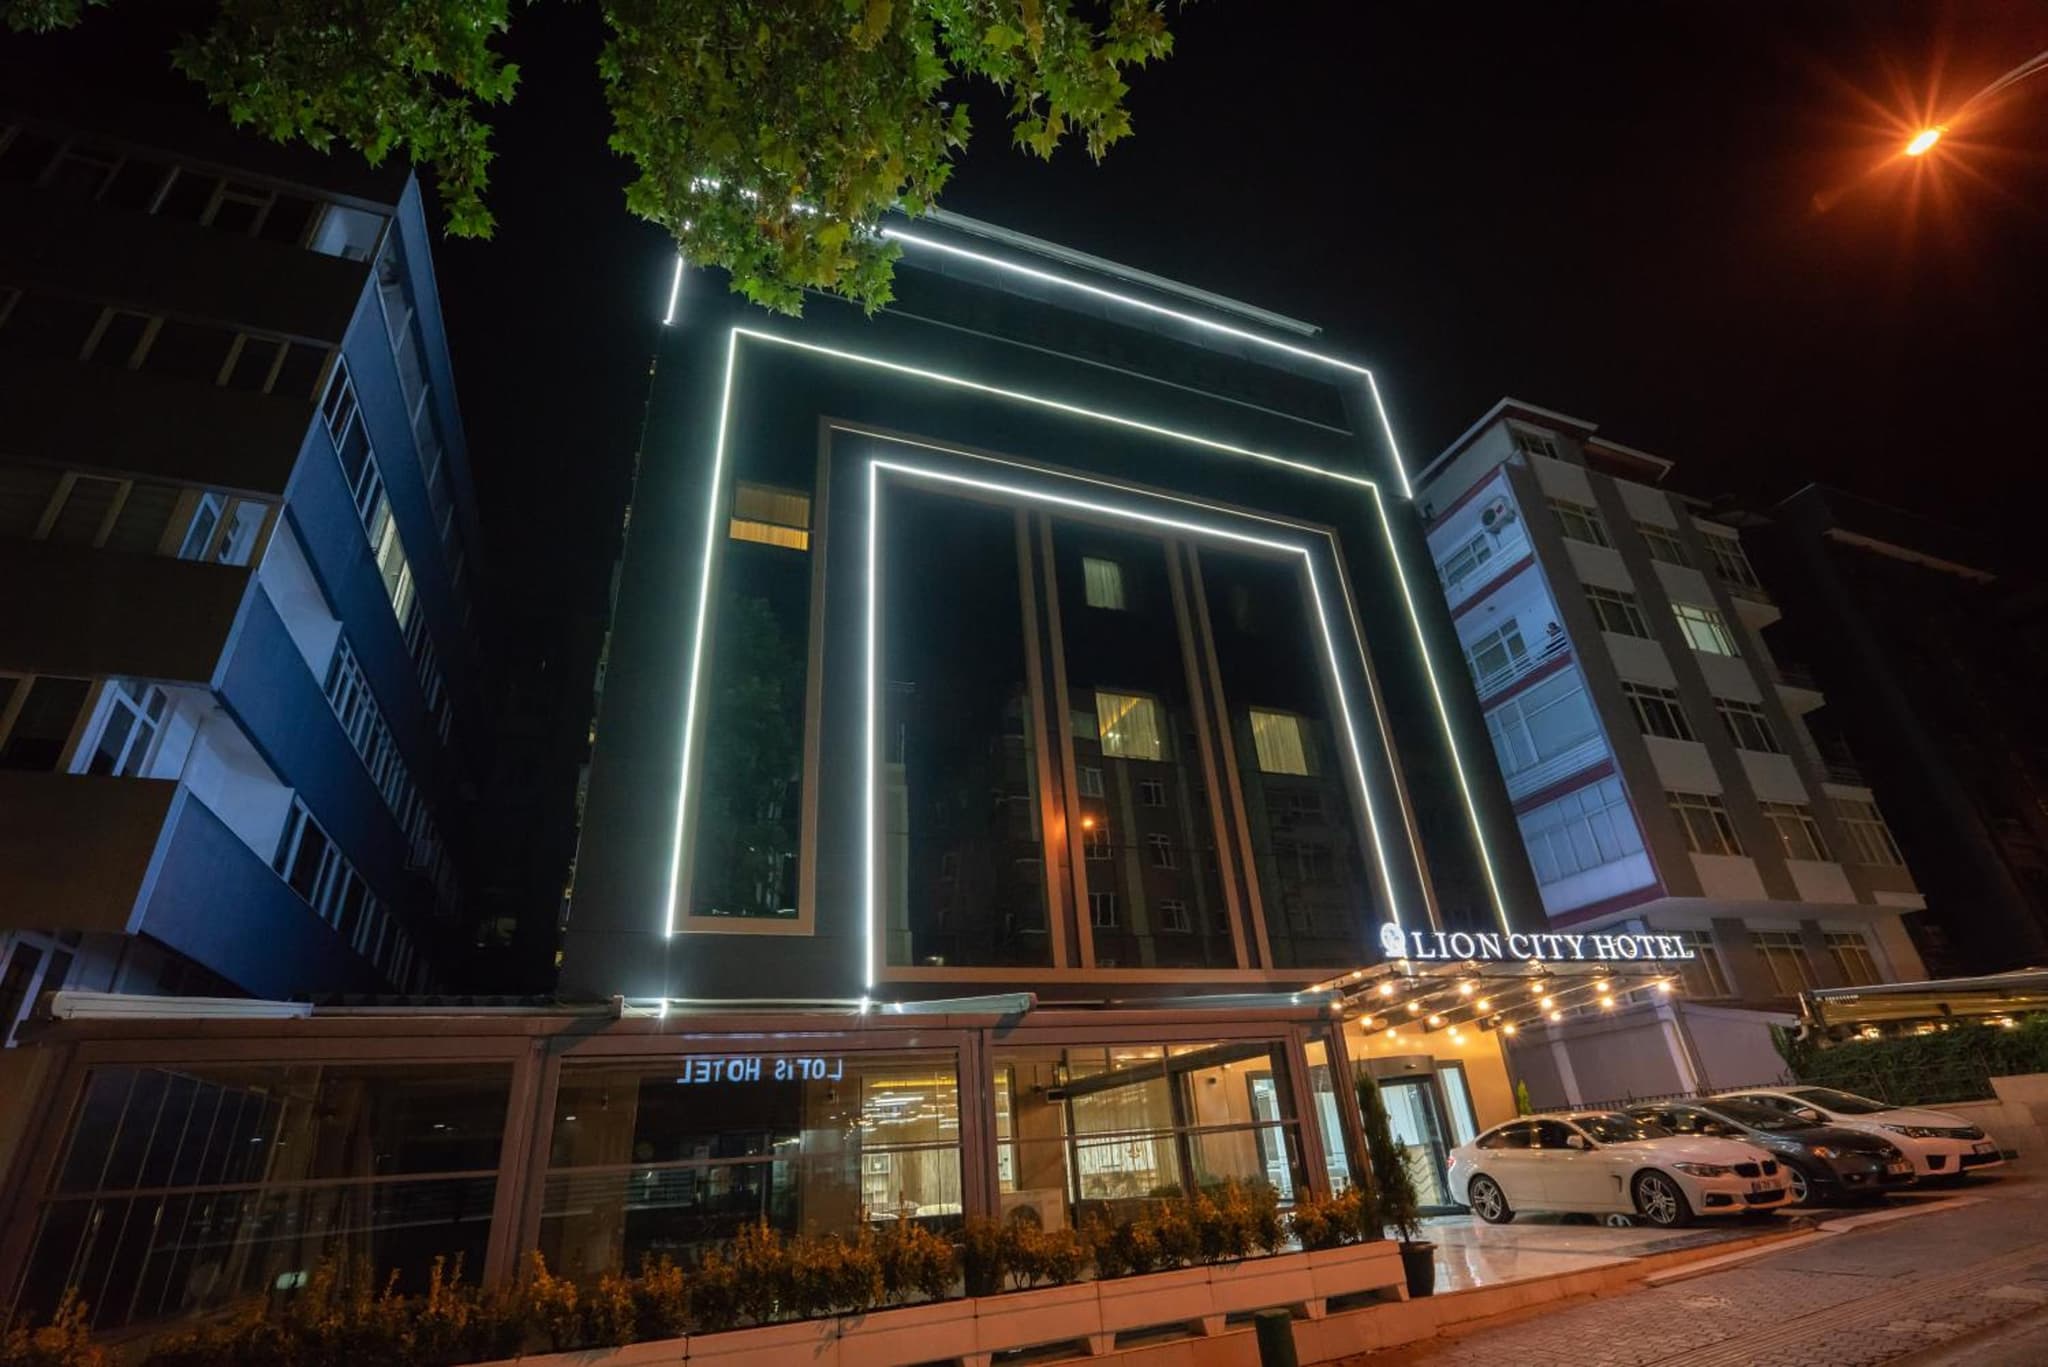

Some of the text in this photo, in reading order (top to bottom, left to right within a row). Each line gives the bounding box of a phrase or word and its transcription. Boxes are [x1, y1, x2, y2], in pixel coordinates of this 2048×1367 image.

[1411, 931, 1696, 960] LION CITY HOTEL
